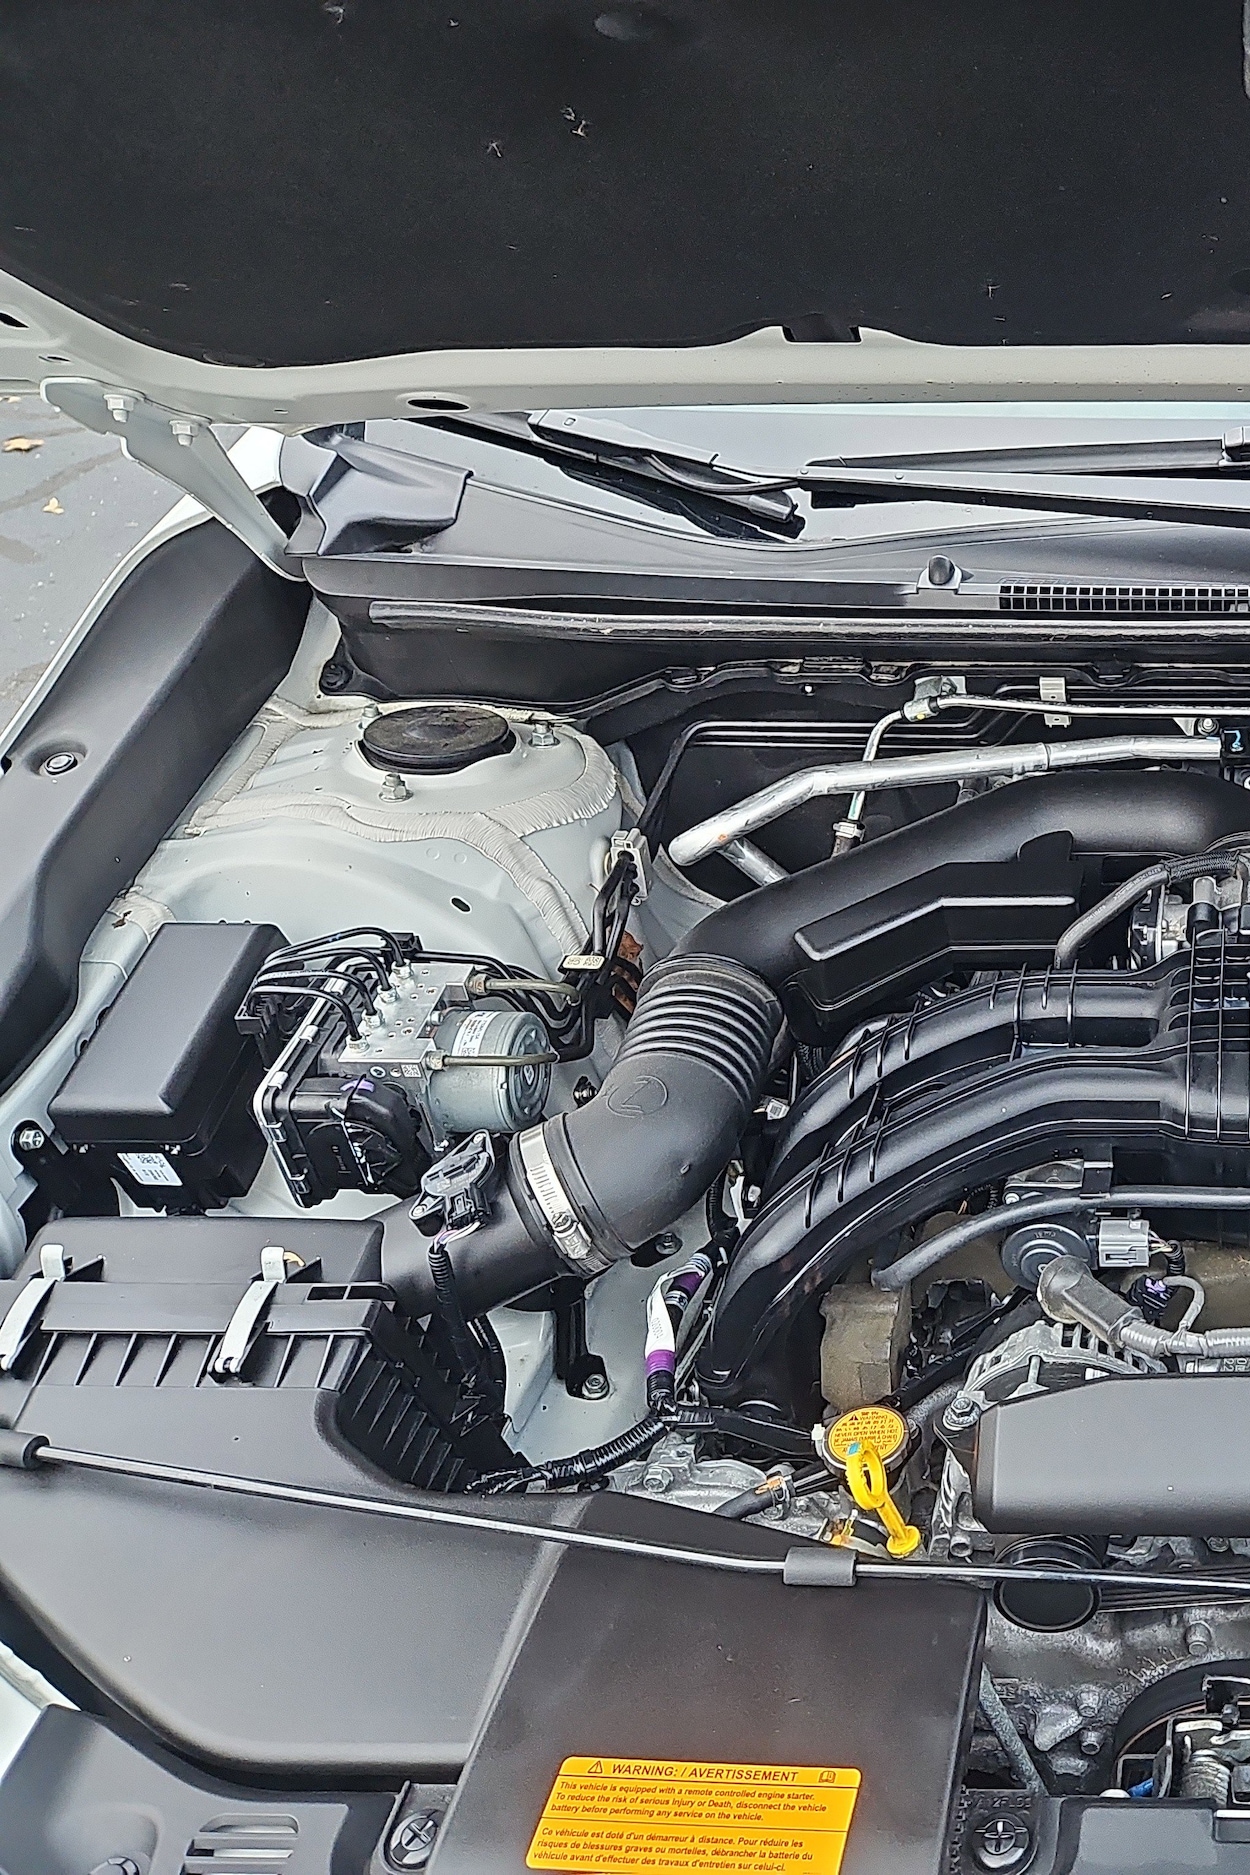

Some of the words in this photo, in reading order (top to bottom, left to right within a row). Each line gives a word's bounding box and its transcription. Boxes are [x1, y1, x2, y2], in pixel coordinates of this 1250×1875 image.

[612, 1764, 678, 1777] WARNING:
[681, 1767, 687, 1777] /
[688, 1767, 798, 1782] AVERTISSEMENT
[560, 1782, 577, 1790] This
[580, 1783, 608, 1791] vehicle
[619, 1785, 657, 1794] equipped
[659, 1786, 676, 1794] with
[684, 1788, 713, 1796] remote
[715, 1789, 756, 1798] controlled
[758, 1792, 785, 1800] engine
[787, 1792, 815, 1800] starter.
[556, 1792, 566, 1800] To
[567, 1793, 595, 1801] reduce
[597, 1794, 610, 1802] the
[612, 1795, 628, 1803] risk
[630, 1796, 639, 1804] of
[640, 1796, 670, 1805] serious
[708, 1800, 733, 1809] Death,
[736, 1801, 781, 1810] disconnect
[783, 1802, 796, 1811] the
[798, 1803, 827, 1812] vehicle
[551, 1804, 579, 1813] battery
[581, 1805, 608, 1814] before
[609, 1806, 654, 1817] performing
[656, 1810, 672, 1818] any
[673, 1810, 703, 1818] service
[718, 1811, 731, 1820] the
[733, 1812, 764, 1821] vehicle.
[555, 1828, 589, 1837] véhicule
[591, 1831, 604, 1839] est
[606, 1831, 624, 1840] doté
[626, 1832, 644, 1841] d'un
[646, 1833, 688, 1842] démarreur
[699, 1835, 735, 1844] distance.
[738, 1837, 758, 1846] Pour
[760, 1838, 789, 1847] réduire
[791, 1839, 804, 1847] les
[537, 1840, 568, 1849] risques
[570, 1841, 581, 1849] de
[583, 1841, 623, 1851] blessures
[625, 1845, 653, 1853] graves
[668, 1846, 709, 1857] mortelles,
[711, 1848, 757, 1859] débrancher
[759, 1850, 767, 1858] la
[769, 1851, 800, 1860] batterie
[802, 1852, 813, 1861] du
[533, 1851, 568, 1860] véhicule
[570, 1854, 593, 1862] avant
[595, 1854, 639, 1865] d'effectuer
[641, 1857, 656, 1866] des
[658, 1858, 689, 1867] travaux
[691, 1860, 736, 1869] d'entretien
[754, 1863, 786, 1872] celui-ci.
